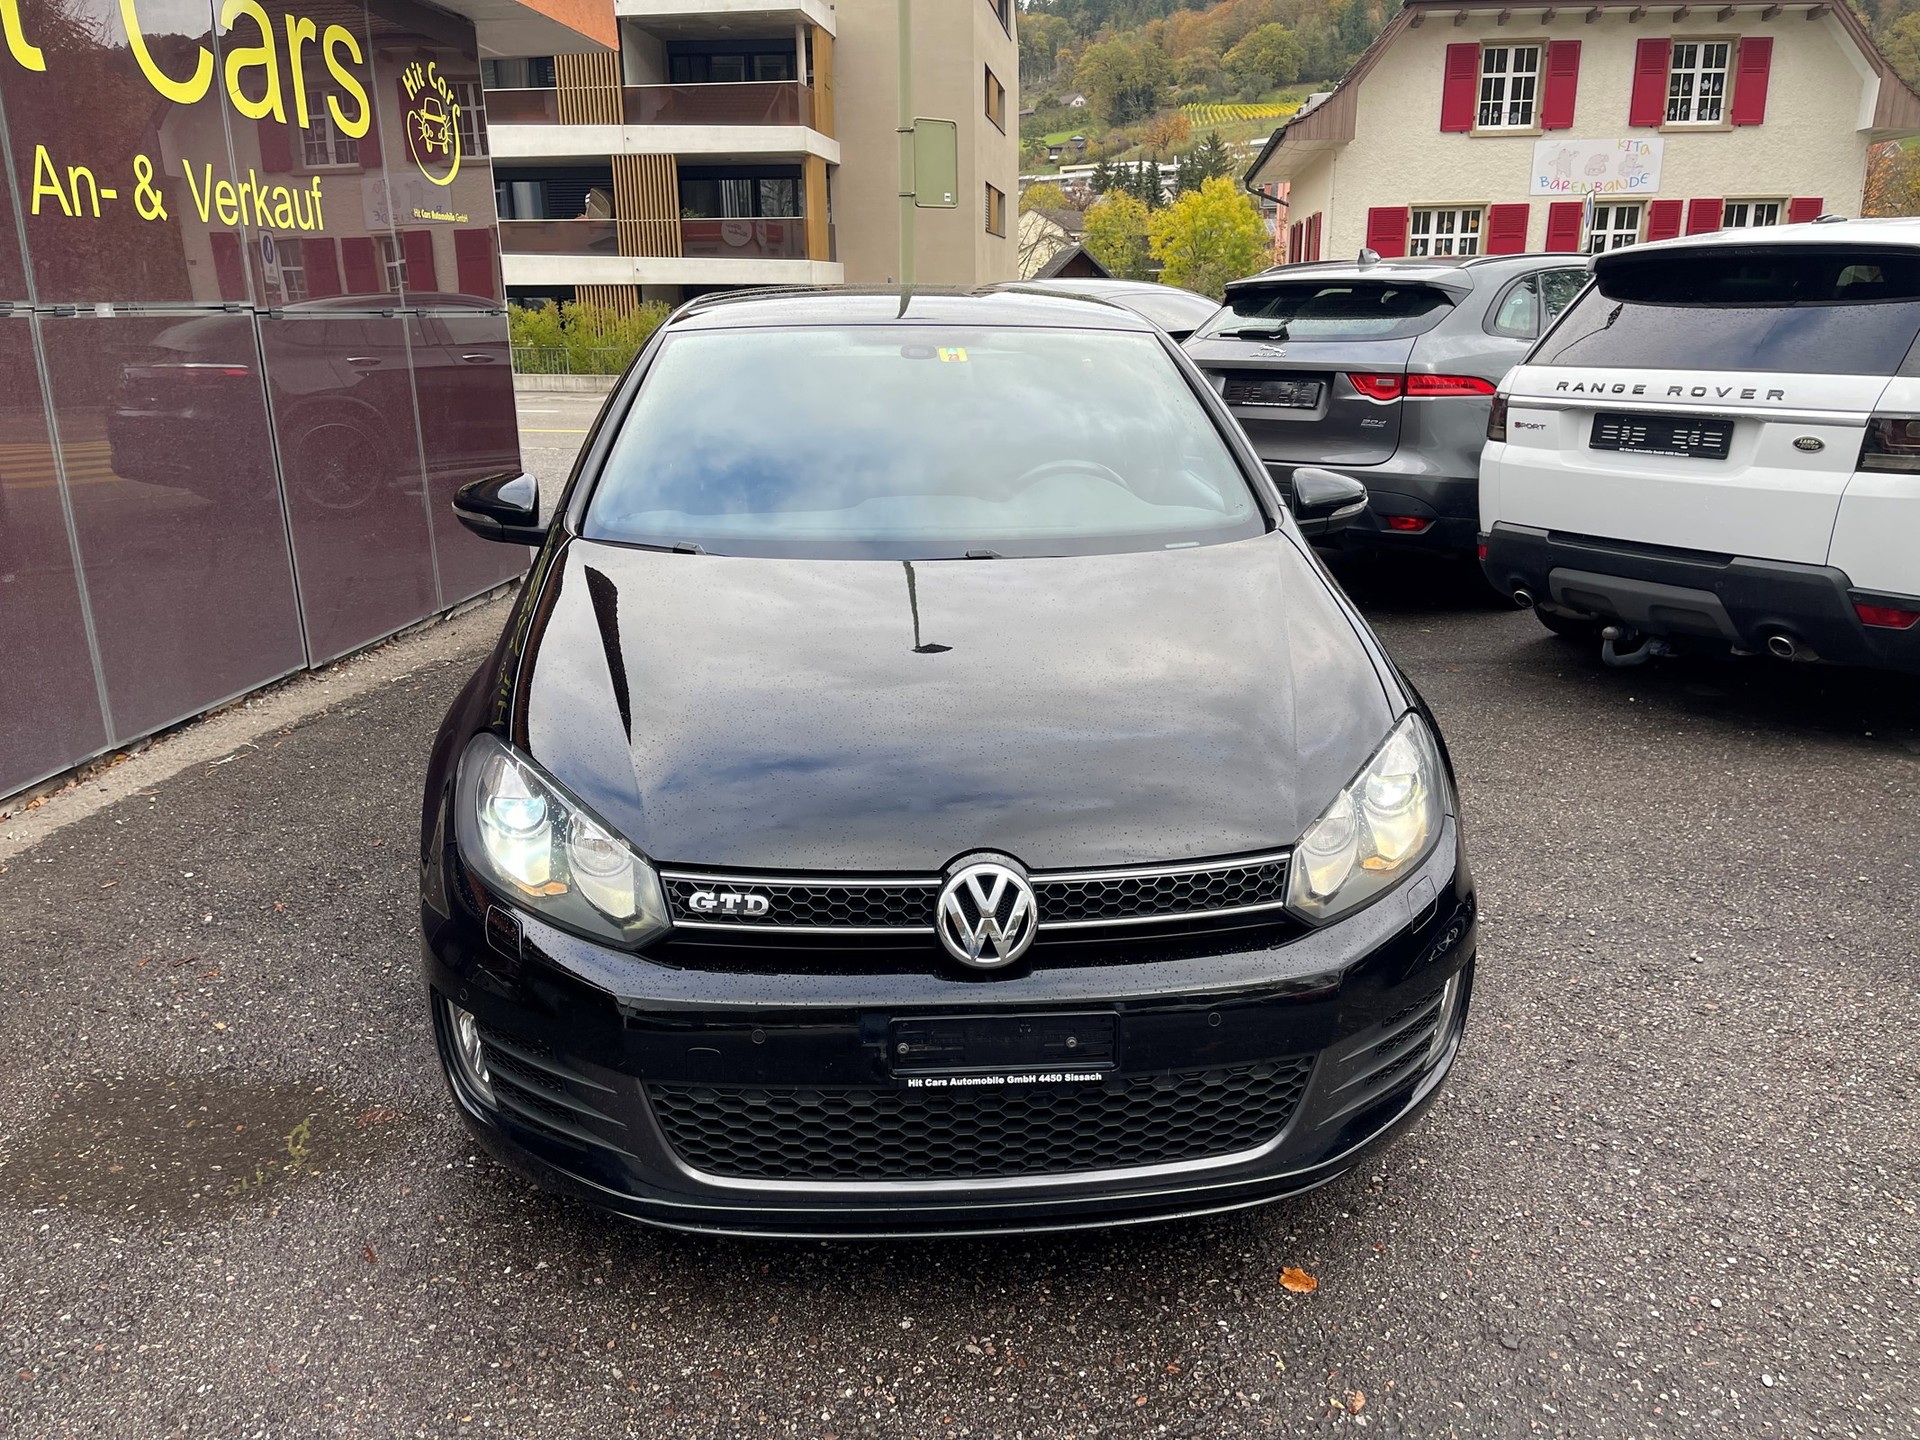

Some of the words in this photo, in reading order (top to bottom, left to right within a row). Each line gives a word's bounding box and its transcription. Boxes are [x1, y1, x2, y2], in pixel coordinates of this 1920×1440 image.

[120, 0, 371, 139] Cars
[402, 62, 425, 101] Hit
[31, 144, 118, 218] An-
[133, 154, 168, 222] &
[182, 159, 325, 231] Verkauf
[1556, 381, 1647, 395] RANGE
[1667, 385, 1785, 401] ROVER
[688, 891, 770, 917] GTD
[907, 1078, 923, 1087] Hit
[925, 1077, 948, 1087] Cars
[949, 1076, 1005, 1086] Automobile
[1006, 1074, 1037, 1084] GmbH
[1038, 1074, 1063, 1082] 4450
[1064, 1073, 1102, 1082] Sissach
